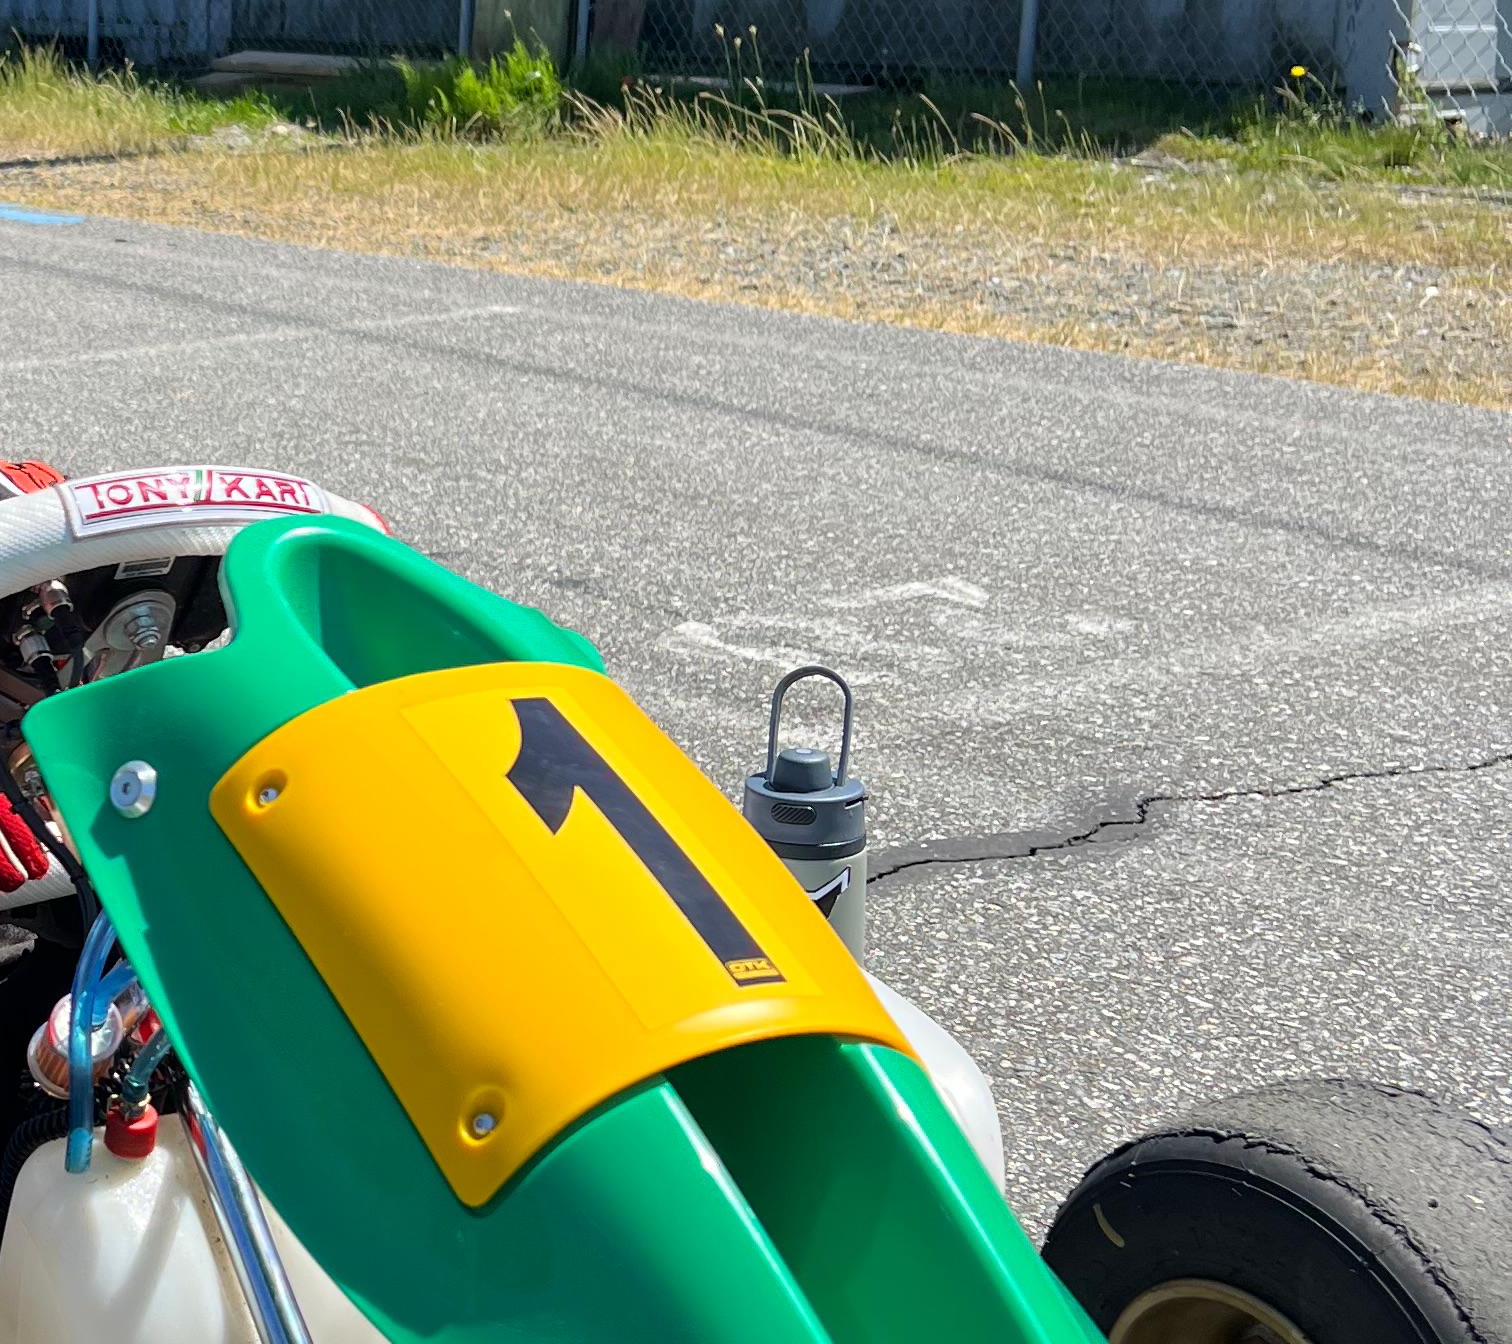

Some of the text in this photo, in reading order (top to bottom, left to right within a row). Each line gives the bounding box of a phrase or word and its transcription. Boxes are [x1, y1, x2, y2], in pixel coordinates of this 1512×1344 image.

[90, 471, 310, 509] TONY KART
[506, 696, 787, 987] 1
